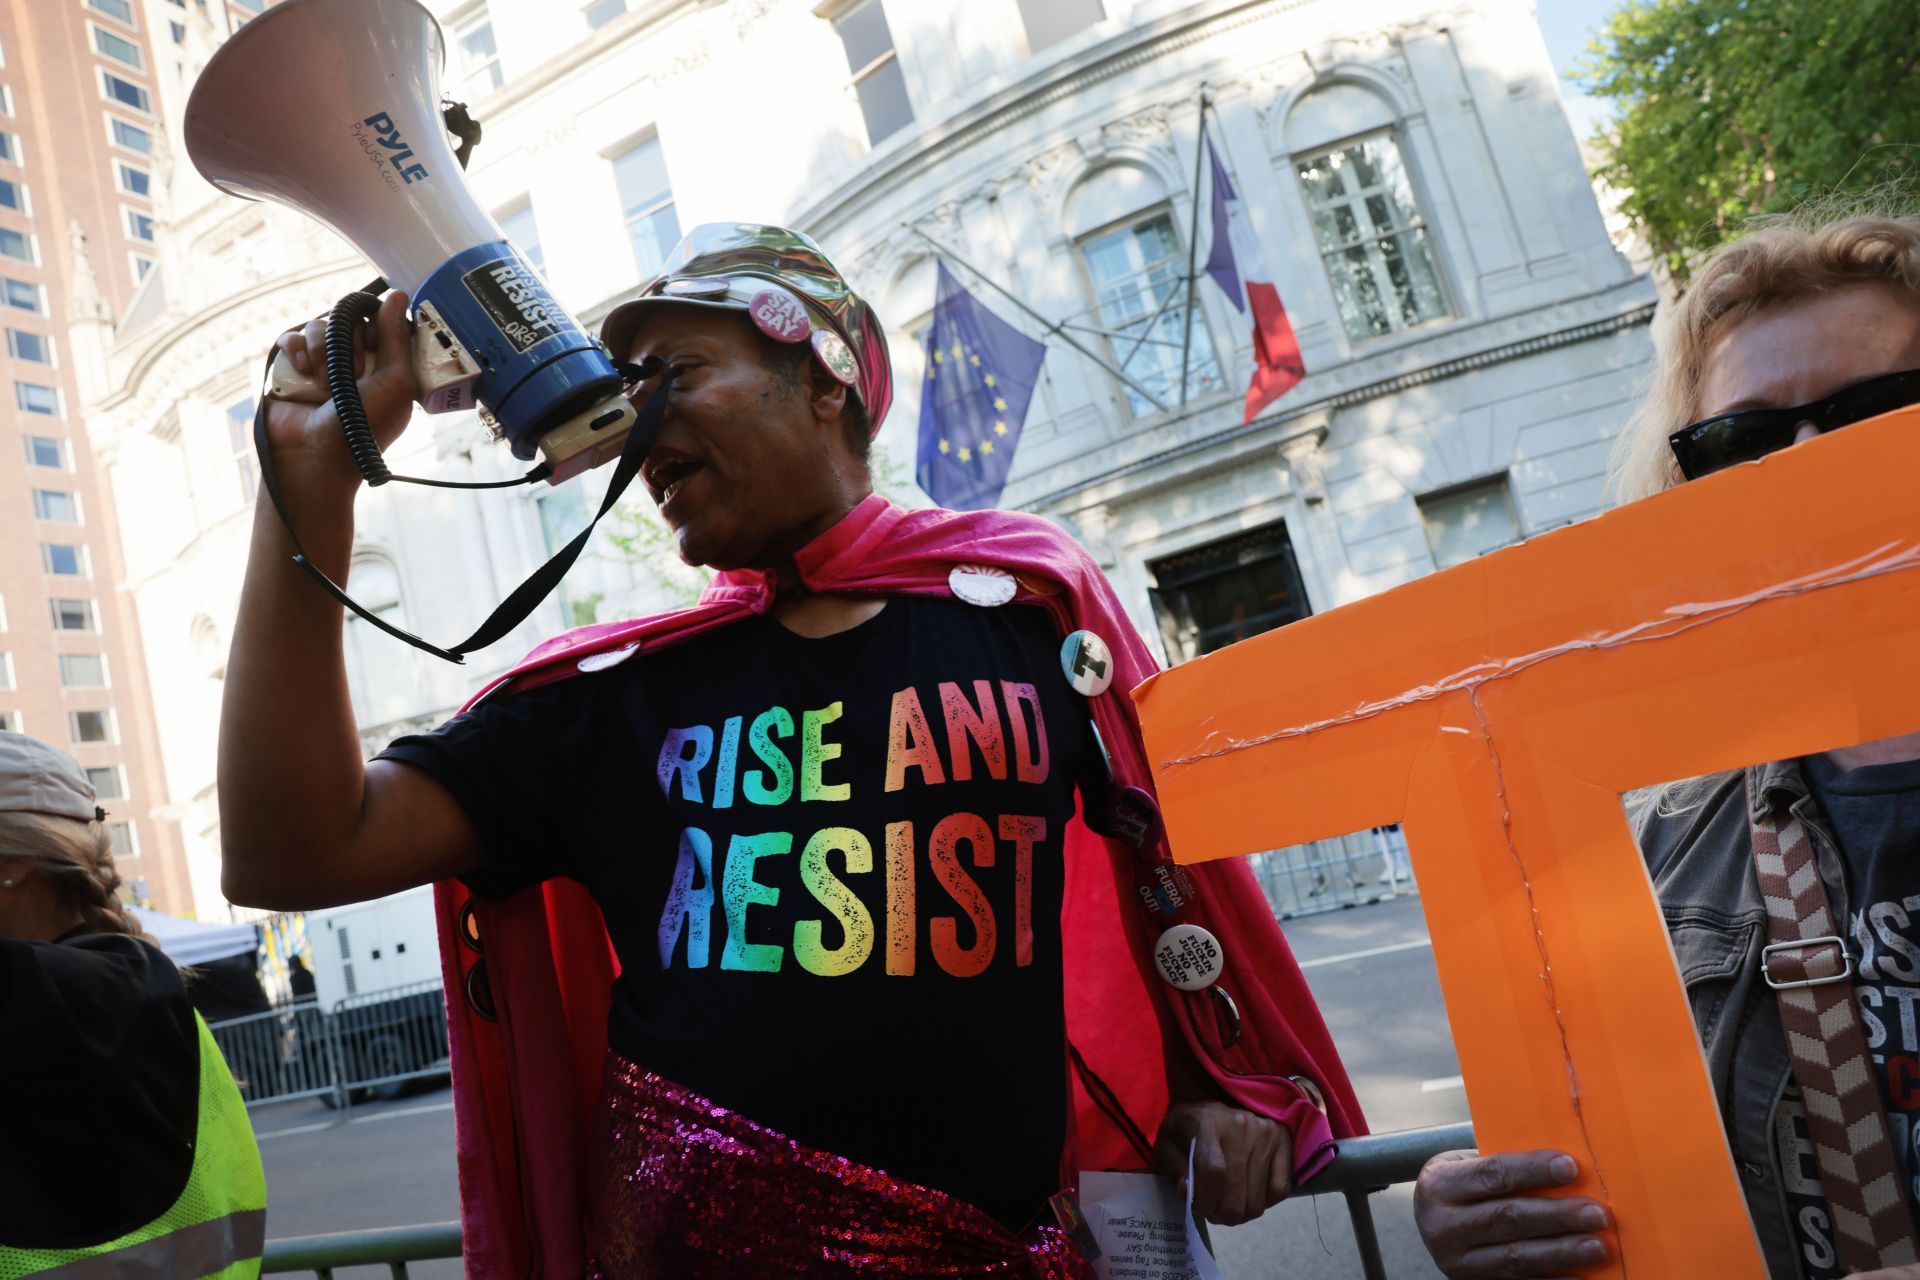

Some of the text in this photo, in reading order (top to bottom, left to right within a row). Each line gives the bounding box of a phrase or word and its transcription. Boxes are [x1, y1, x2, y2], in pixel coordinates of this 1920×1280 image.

[350, 122, 401, 193] PyleUSA.com
[364, 111, 429, 185] PYLE
[490, 265, 557, 334] RESIST
[767, 292, 805, 323] SAY
[756, 304, 799, 337] GAY
[656, 678, 1050, 809] RISE AND
[657, 812, 1048, 978] RESIST
[1139, 885, 1161, 913] OUT!
[1162, 945, 1190, 983] FUCKIN
[1177, 953, 1192, 969] NO
[1178, 938, 1207, 977] JUSTICE
[1187, 934, 1214, 973] FUCKIN
[1201, 938, 1217, 959] NO
[1157, 952, 1181, 985] PEACE
[1107, 1217, 1184, 1232] RESISTANCE wear
[1125, 1243, 1186, 1256] omething SAY
[1135, 1254, 1150, 1266] Tag
[1152, 1257, 1186, 1268] stance
